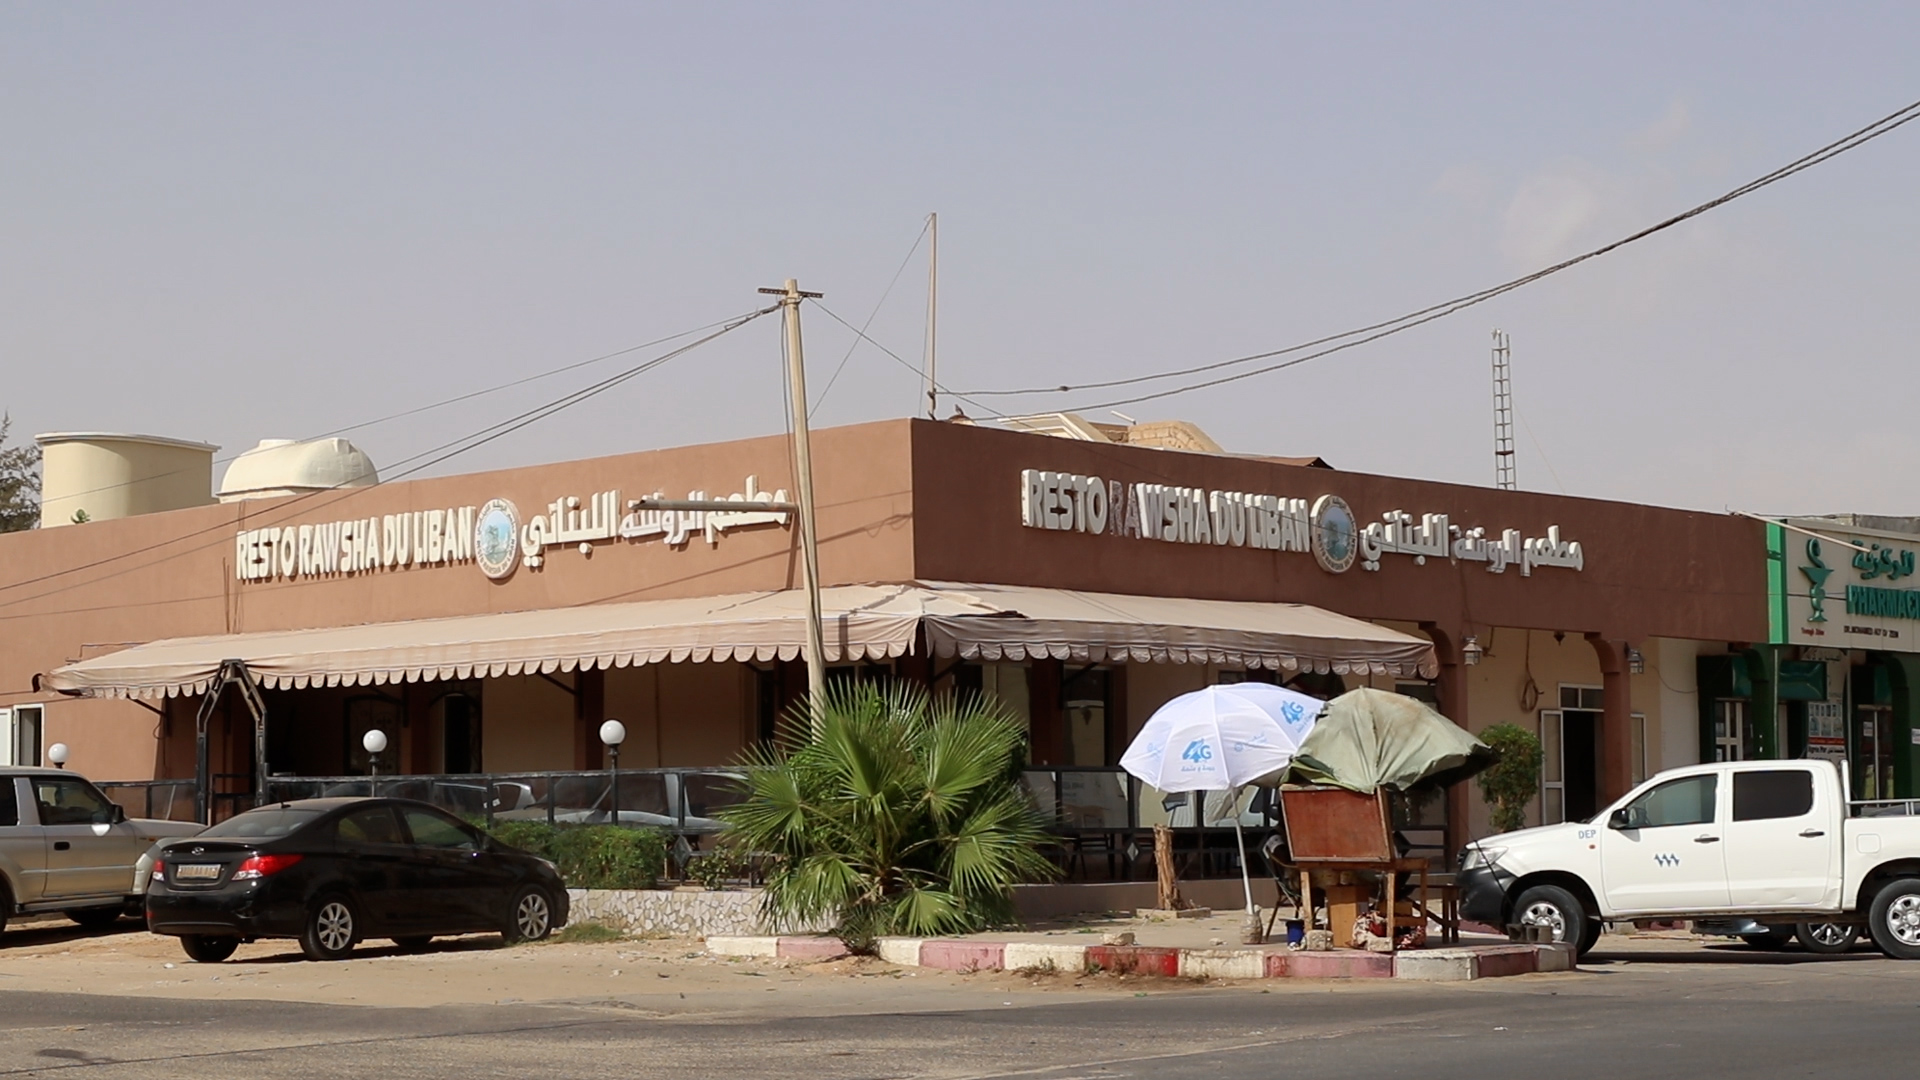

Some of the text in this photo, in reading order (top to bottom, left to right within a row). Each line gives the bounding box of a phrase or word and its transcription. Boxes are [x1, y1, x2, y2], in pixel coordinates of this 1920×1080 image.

[706, 474, 789, 544] مطعم
[1021, 469, 1107, 535] RESTO
[1109, 480, 1212, 546] RAWSHA
[1211, 490, 1246, 548] DU
[1244, 492, 1311, 553] LIBAN
[236, 526, 296, 581] RESTO
[298, 516, 380, 576] RAWSHA
[382, 512, 414, 567] DU
[413, 505, 477, 564] LIBAN
[1359, 509, 1449, 571] اللبناني
[1520, 525, 1584, 577] مطعم
[1281, 700, 1304, 725] 4G
[1182, 738, 1212, 763] 4G
[1578, 829, 1597, 840] DEP
